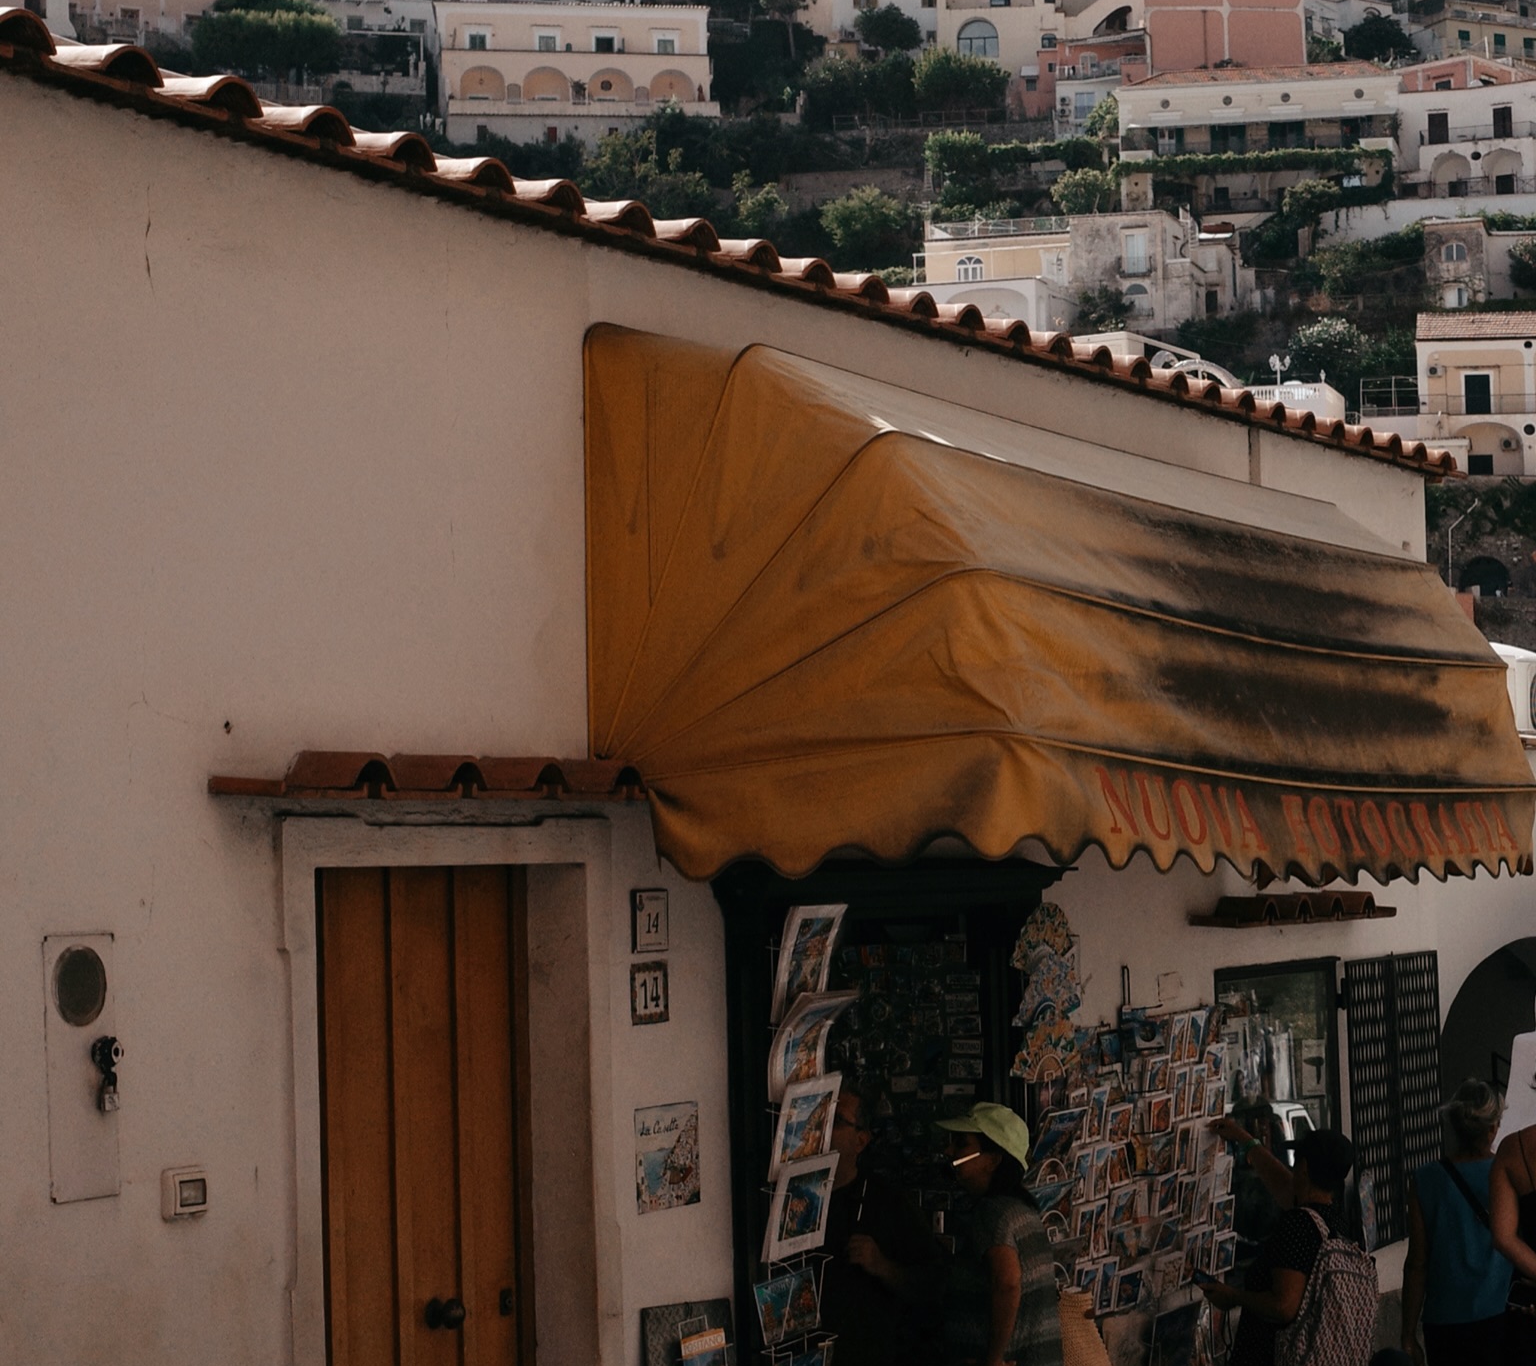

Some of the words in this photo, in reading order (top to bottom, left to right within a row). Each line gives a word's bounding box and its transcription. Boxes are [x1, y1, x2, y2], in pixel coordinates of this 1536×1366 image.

[1095, 766, 1269, 851] NUOVA
[1280, 793, 1518, 857] FOTOGRAFIA
[646, 911, 660, 934] 14
[640, 976, 661, 1009] 14
